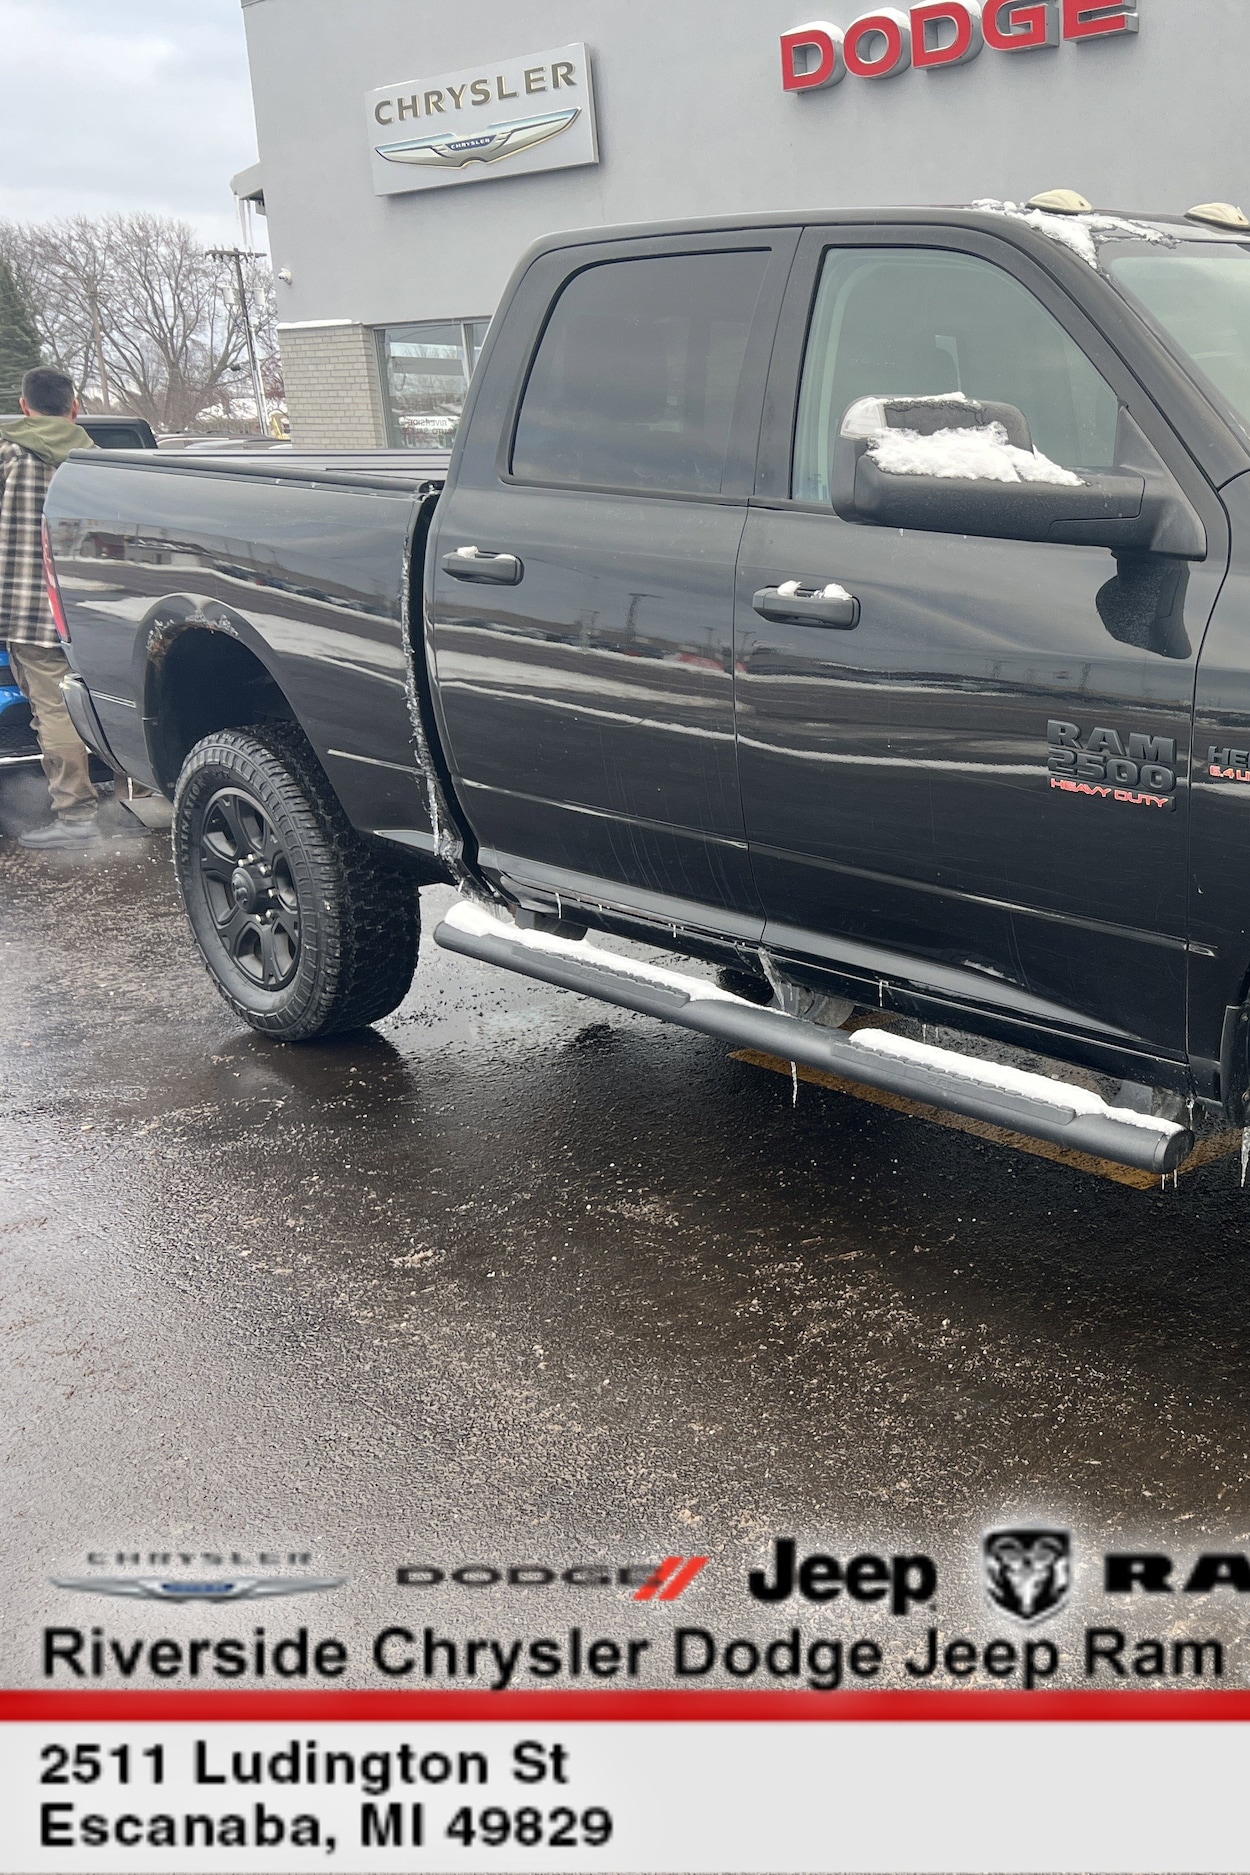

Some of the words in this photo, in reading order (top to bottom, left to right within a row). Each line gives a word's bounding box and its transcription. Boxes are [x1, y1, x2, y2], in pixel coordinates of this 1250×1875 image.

[779, 0, 1130, 92] DODGE
[374, 61, 578, 126] CHRYSLER
[450, 137, 491, 150] CHRYSLER
[1047, 719, 1177, 764] RAM
[1047, 747, 1177, 792] 2500
[1209, 765, 1235, 781] 6.4
[1050, 778, 1112, 798] HEAVY
[1114, 789, 1169, 809] DUTY
